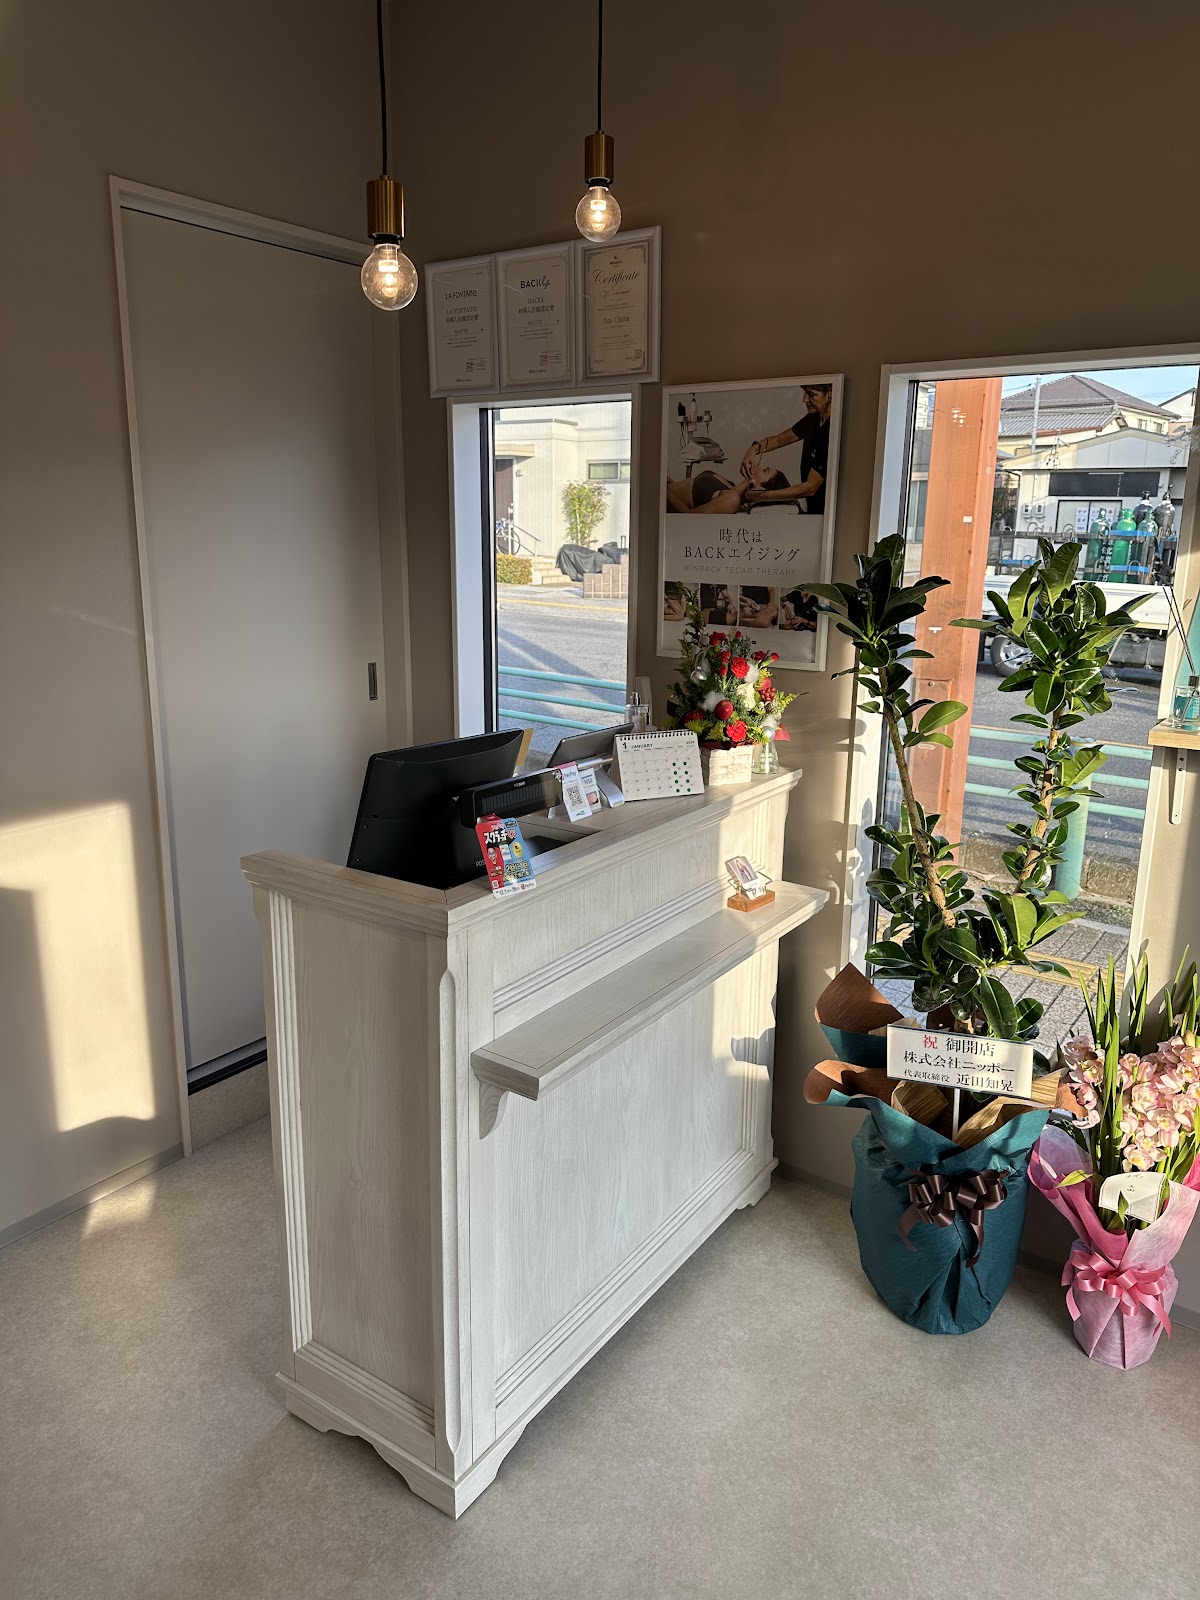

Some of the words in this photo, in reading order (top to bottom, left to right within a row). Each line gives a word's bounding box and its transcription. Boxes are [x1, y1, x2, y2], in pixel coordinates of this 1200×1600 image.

[593, 268, 640, 288] Certificate
[453, 290, 478, 298] FONTAINE
[454, 306, 478, 314] FONTAINE
[719, 528, 763, 544] 時代は
[684, 546, 801, 562] BACKエイジング
[683, 565, 721, 573] WINBACK
[725, 566, 753, 575] TECAR
[757, 568, 797, 577] THERAPY
[922, 1034, 939, 1050] 祝
[945, 1037, 996, 1057] 御開店
[903, 1050, 1015, 1074] 株式会社ニッポー
[904, 1068, 950, 1083] 代表取締役
